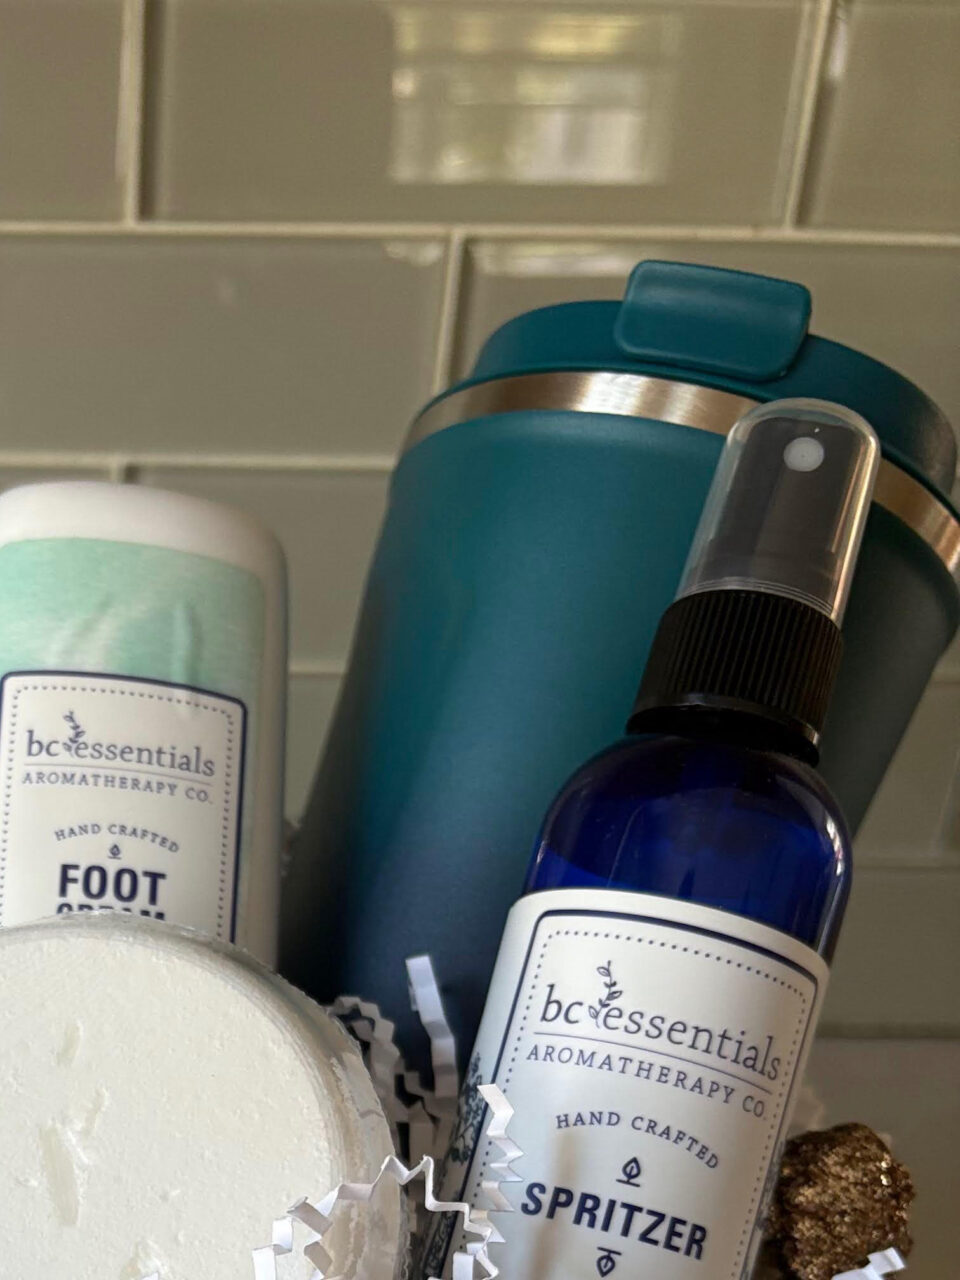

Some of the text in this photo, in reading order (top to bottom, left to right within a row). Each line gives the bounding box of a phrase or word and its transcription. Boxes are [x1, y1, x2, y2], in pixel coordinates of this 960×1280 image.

[25, 729, 216, 777] bc essentials
[21, 771, 214, 804] AROMATHERAPY CO.
[54, 823, 180, 853] HAND CRAFTED
[58, 863, 167, 906] FOOT
[539, 983, 782, 1081] bc essentials
[526, 1044, 767, 1121] AROMATHERAPY CO.
[556, 1111, 720, 1169] HAND CRAFTED
[520, 1182, 708, 1261] SPRITZER
